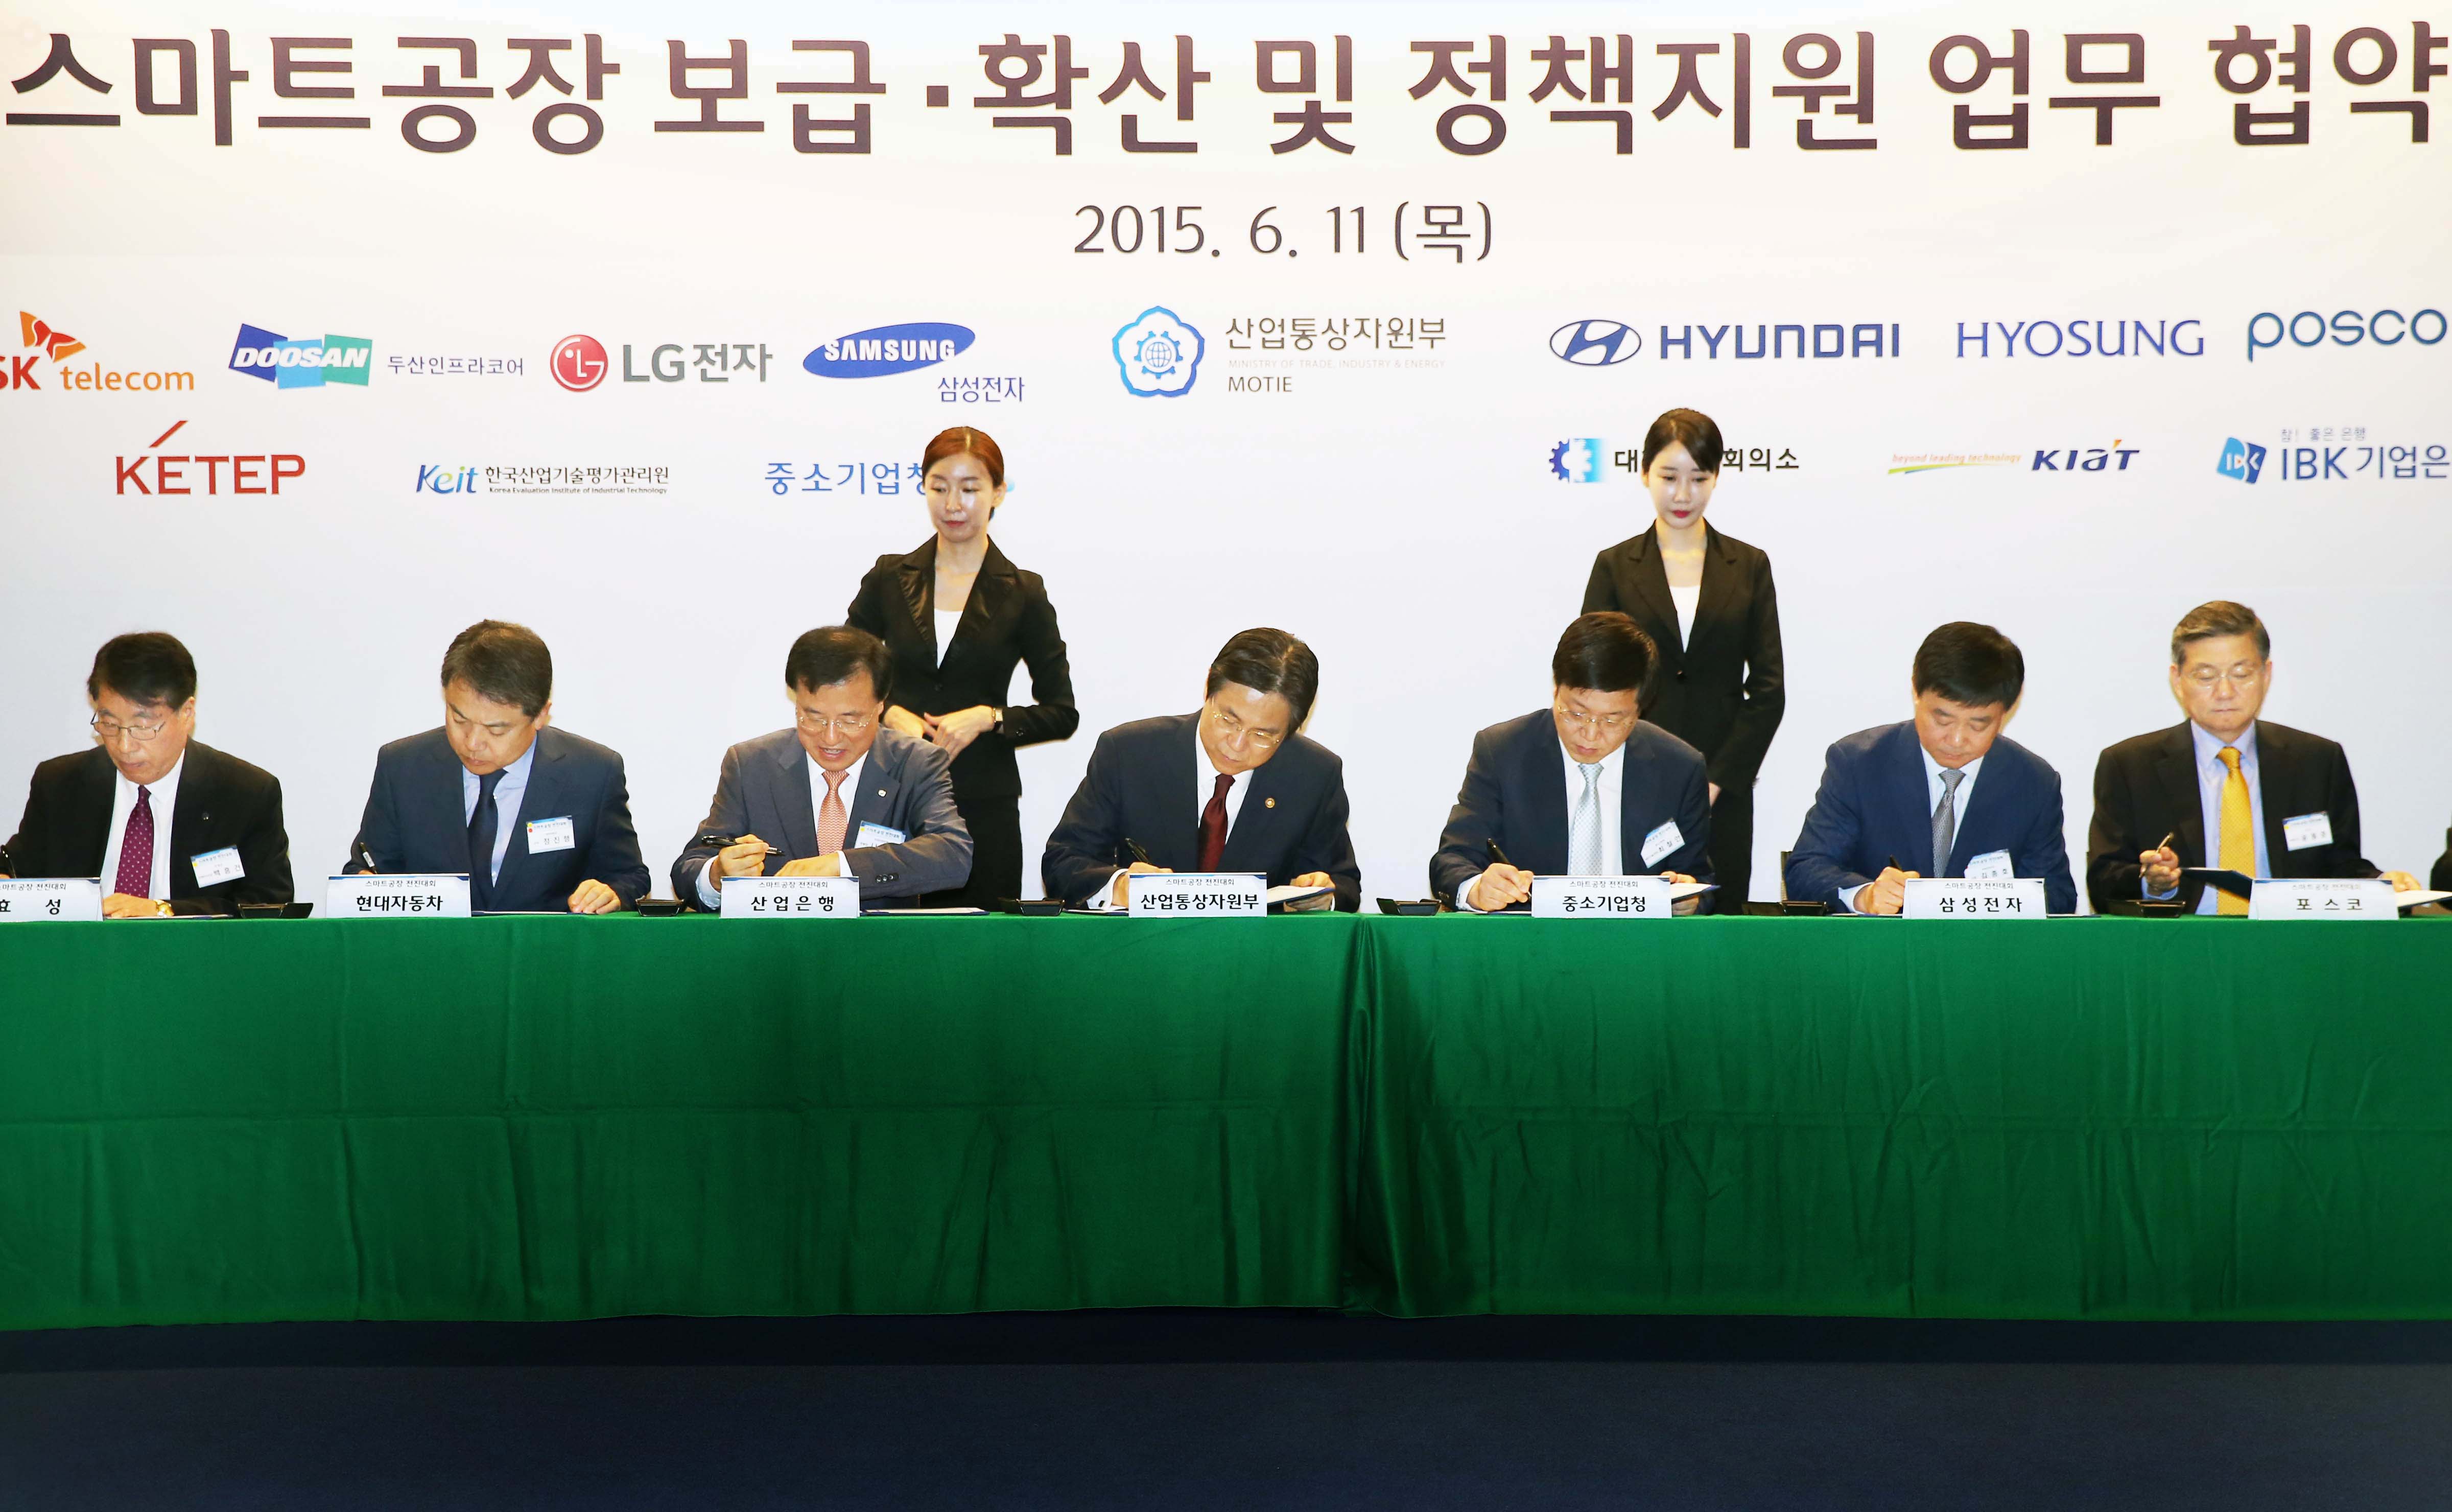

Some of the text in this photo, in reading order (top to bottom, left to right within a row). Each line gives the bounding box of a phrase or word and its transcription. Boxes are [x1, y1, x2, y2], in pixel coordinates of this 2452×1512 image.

[5, 28, 622, 156] 스마트공장
[1254, 34, 1356, 156] 및
[1406, 31, 1878, 157] 정책지원
[1928, 28, 2161, 152] 업무
[2206, 20, 2449, 148] 협약
[1074, 205, 1220, 258] 2015.
[1249, 205, 1298, 258] 6.
[1225, 317, 1446, 351] 산업통상자원부
[1660, 323, 1900, 360] HYUNDAI
[1956, 319, 2204, 359] HYOSUNG
[233, 347, 370, 369] DOOSAN
[823, 339, 957, 362] SAMSUNG
[388, 356, 523, 376] 두산인프라코어
[623, 343, 773, 383] LG전자
[59, 362, 195, 390] telecom
[1228, 375, 1292, 393] MOTIE
[937, 376, 1025, 403] 삼성전자
[416, 464, 479, 494] Keit
[485, 466, 668, 485] 한국산업기술평가관리원
[626, 487, 667, 495] Technology
[0, 883, 34, 891] 마트공장
[366, 880, 403, 888] 스마트공장
[1165, 878, 1234, 886] 스마트공장 전진대회
[356, 895, 443, 912] 현대자동차
[1140, 893, 1259, 910] 산업통상자원부
[1562, 896, 1645, 912] 중소기업청
